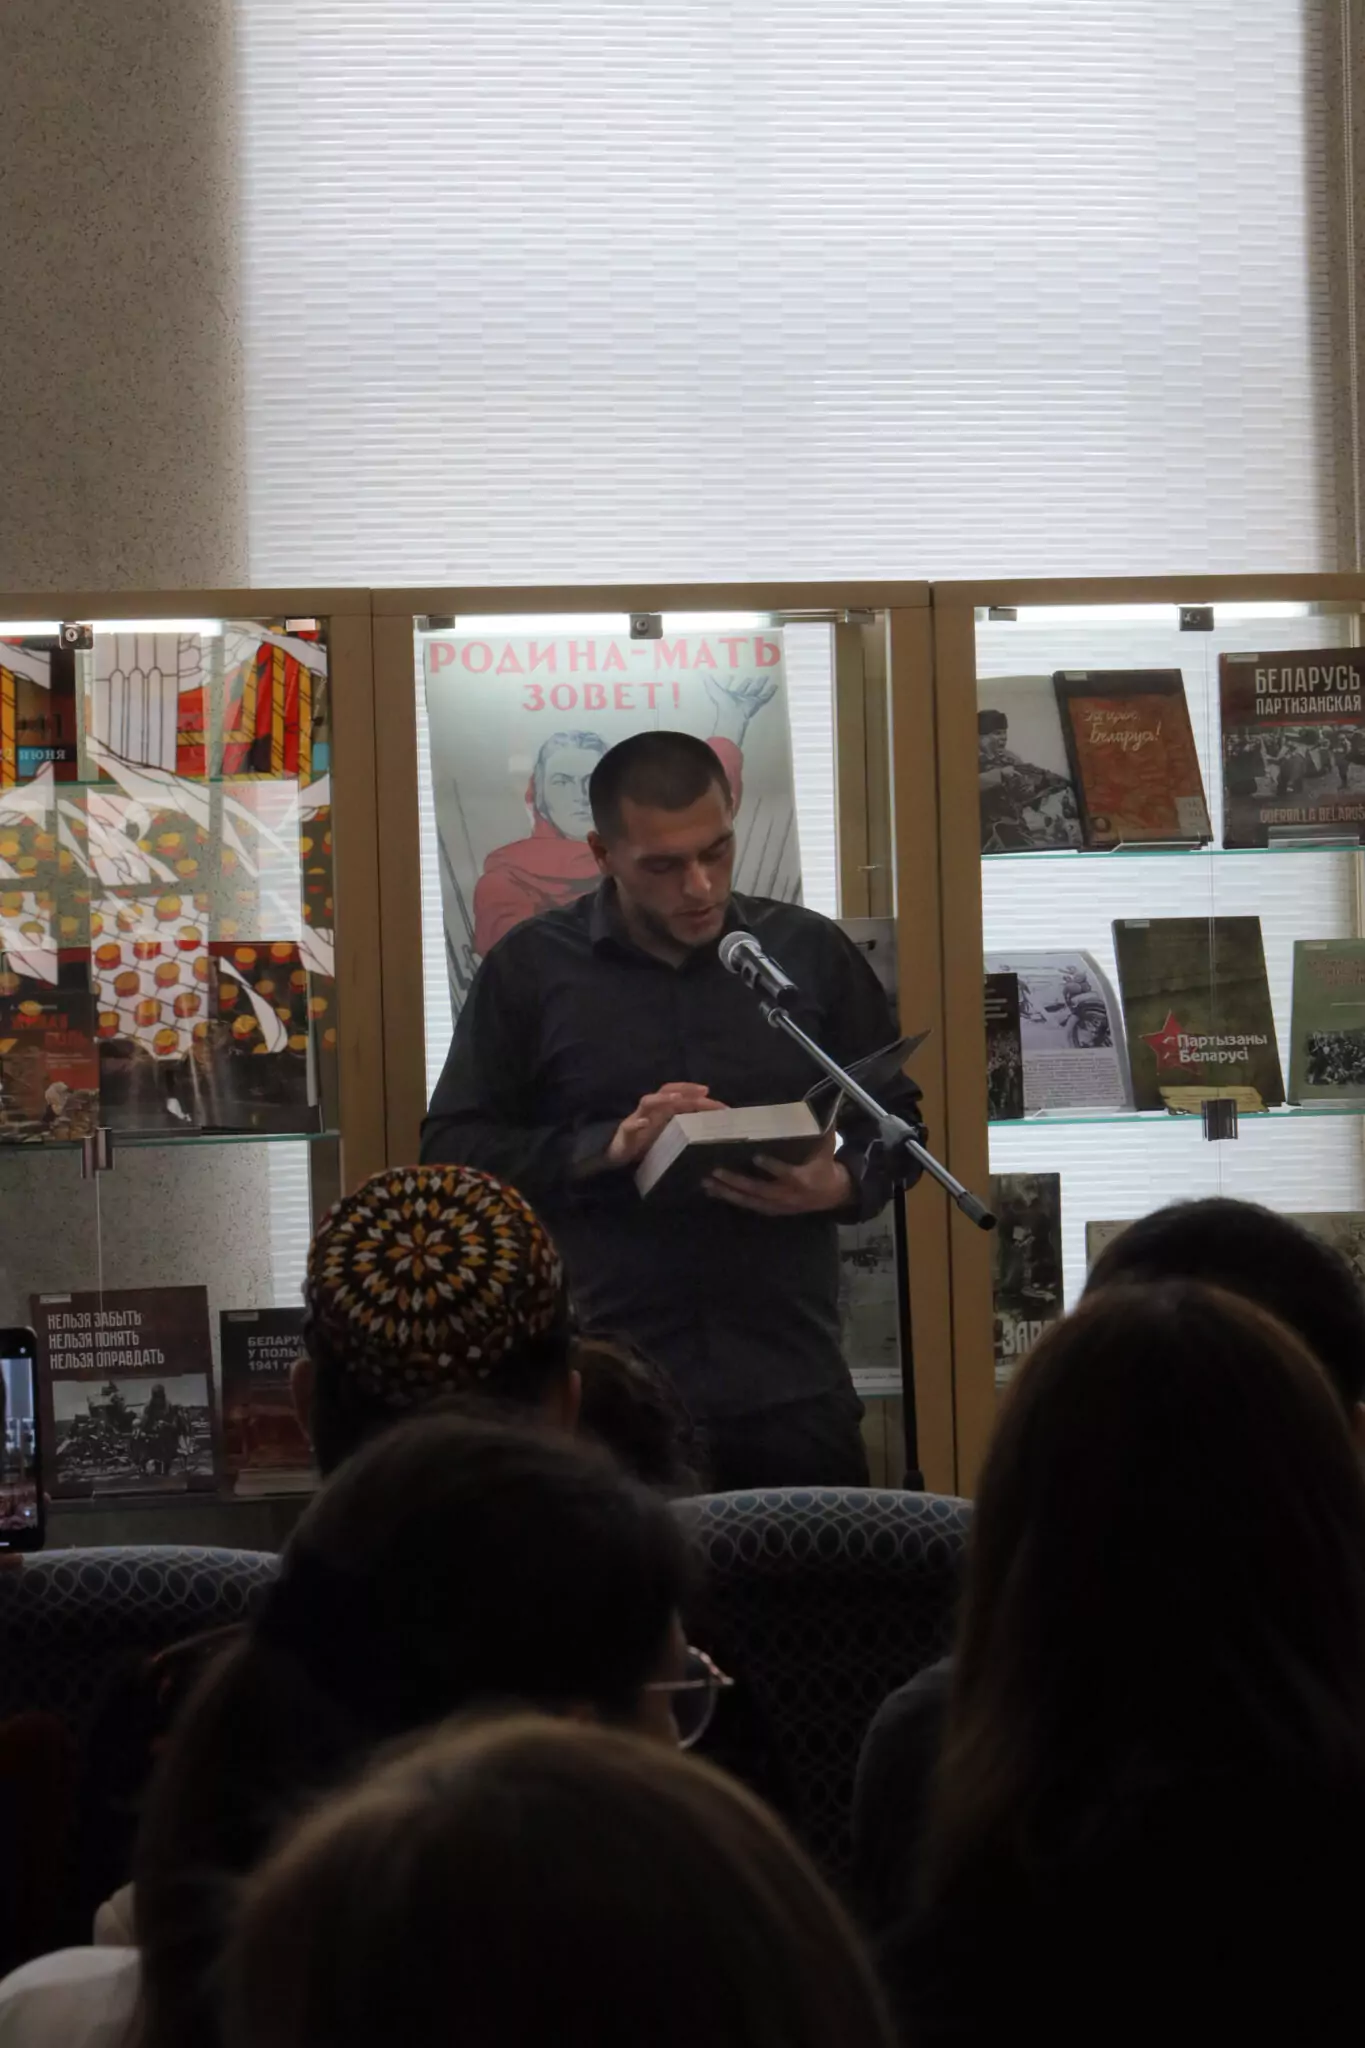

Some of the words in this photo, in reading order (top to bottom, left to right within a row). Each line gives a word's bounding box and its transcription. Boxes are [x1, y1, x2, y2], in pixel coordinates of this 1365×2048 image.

[429, 636, 781, 675] РОДИНА-МАТЬ
[1255, 665, 1360, 693] БЕЛАРУСЬ
[522, 681, 680, 711] ЗОВЕТ!
[1256, 695, 1362, 715] ПАРТИЗАНСКАЯ
[1178, 1034, 1267, 1049] Партызаны
[1180, 1047, 1248, 1063] Беларусі
[47, 1313, 91, 1330] НЕЛЬЗЯ
[94, 1310, 141, 1327] ЗАБЫТЬ
[49, 1332, 92, 1349] НЕЛЬЗЯ
[95, 1330, 139, 1347] ПОНЯТЬ
[50, 1352, 94, 1370] НЕЛЬЗЯ
[96, 1348, 165, 1367] ОПРАВДАТЬ
[248, 1361, 278, 1371] 1941
